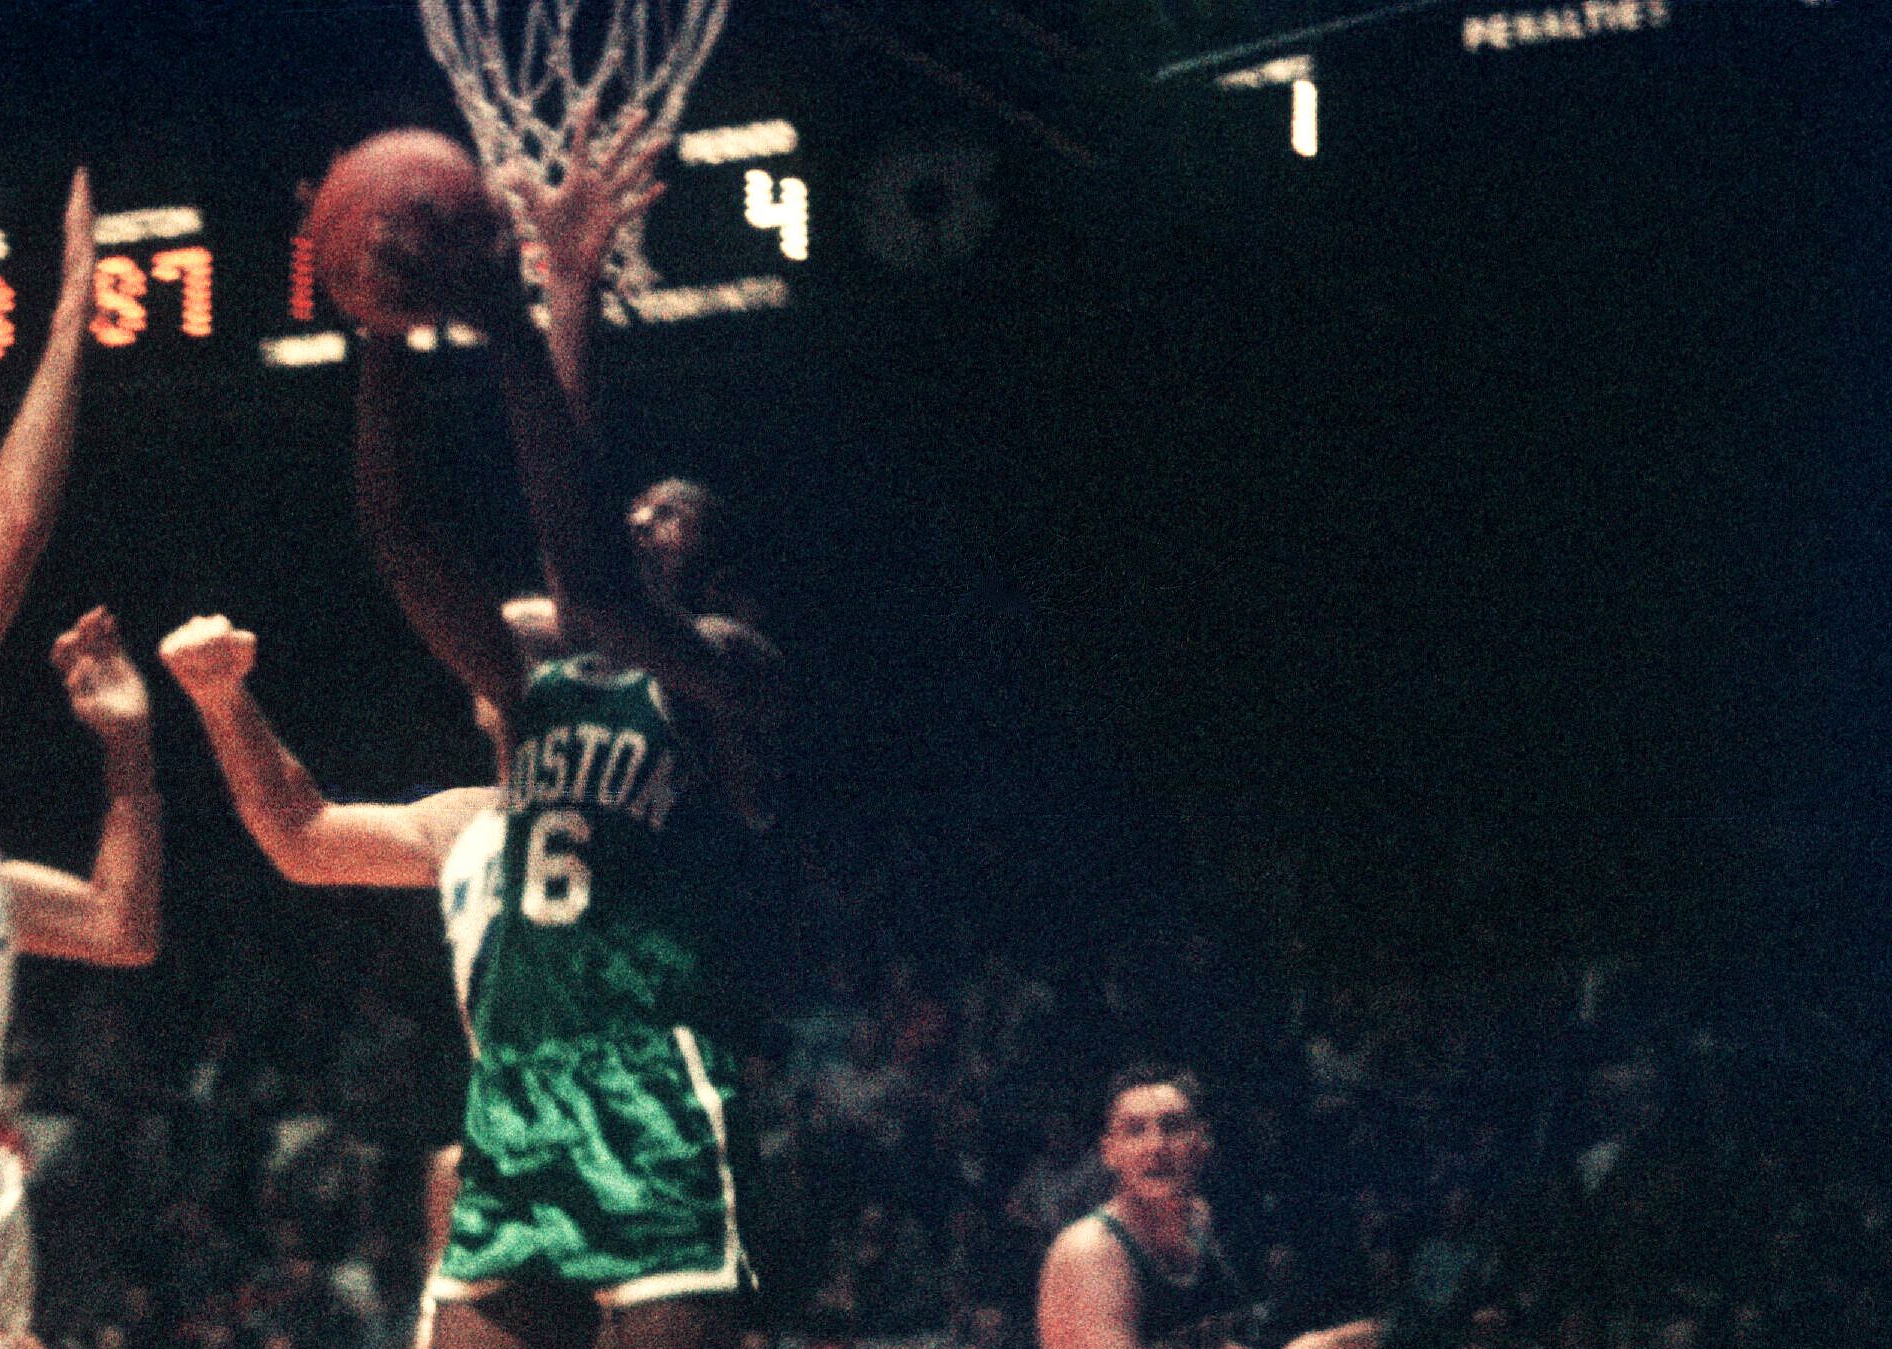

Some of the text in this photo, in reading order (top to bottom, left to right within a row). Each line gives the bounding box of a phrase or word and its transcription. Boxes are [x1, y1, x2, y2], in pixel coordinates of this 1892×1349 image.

[744, 169, 808, 262] 4
[508, 724, 674, 830] OSTON
[521, 810, 592, 926] 6
